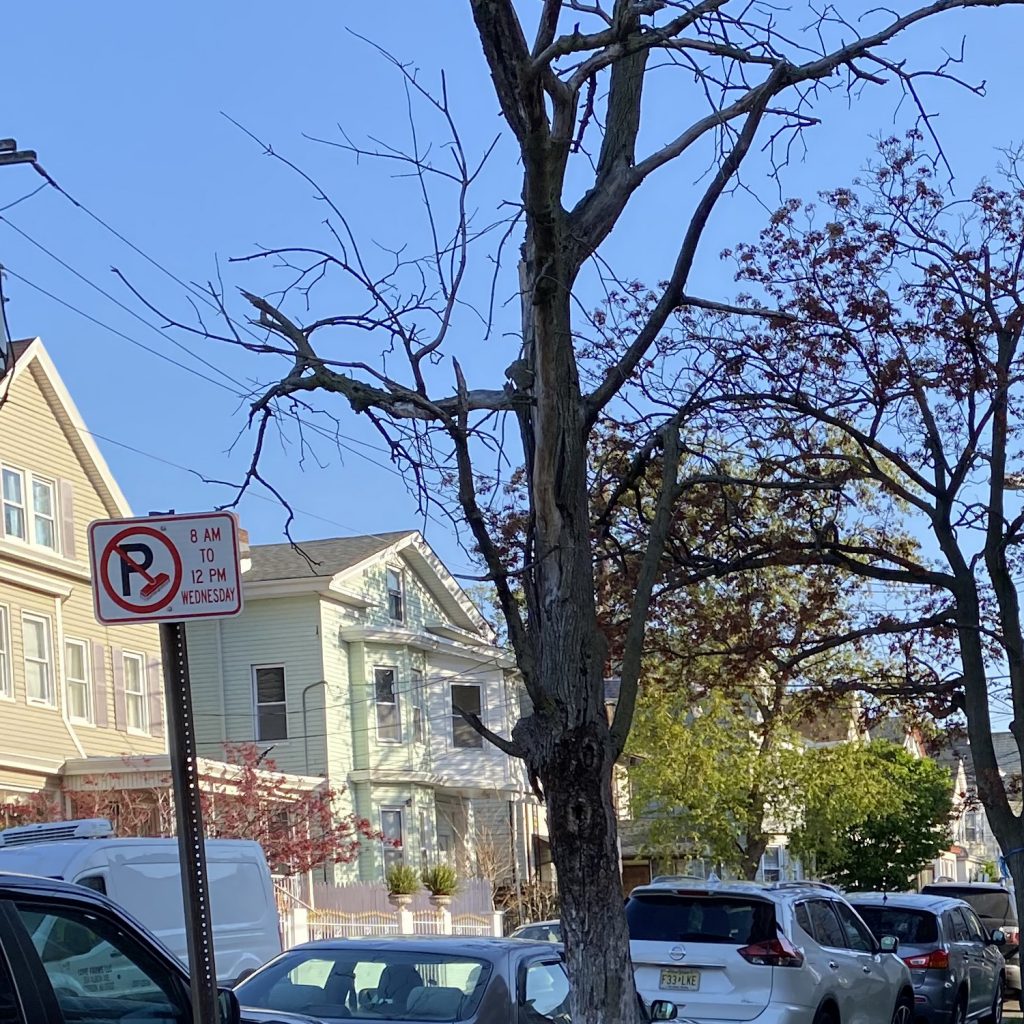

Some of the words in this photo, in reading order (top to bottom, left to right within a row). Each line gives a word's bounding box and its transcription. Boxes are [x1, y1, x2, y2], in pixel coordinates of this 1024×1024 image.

[190, 530, 198, 543] 8
[203, 527, 221, 541] AM
[200, 548, 214, 563] TO
[191, 570, 204, 584] 12
[209, 567, 226, 583] PM
[181, 588, 235, 605] WEDNESDAY
